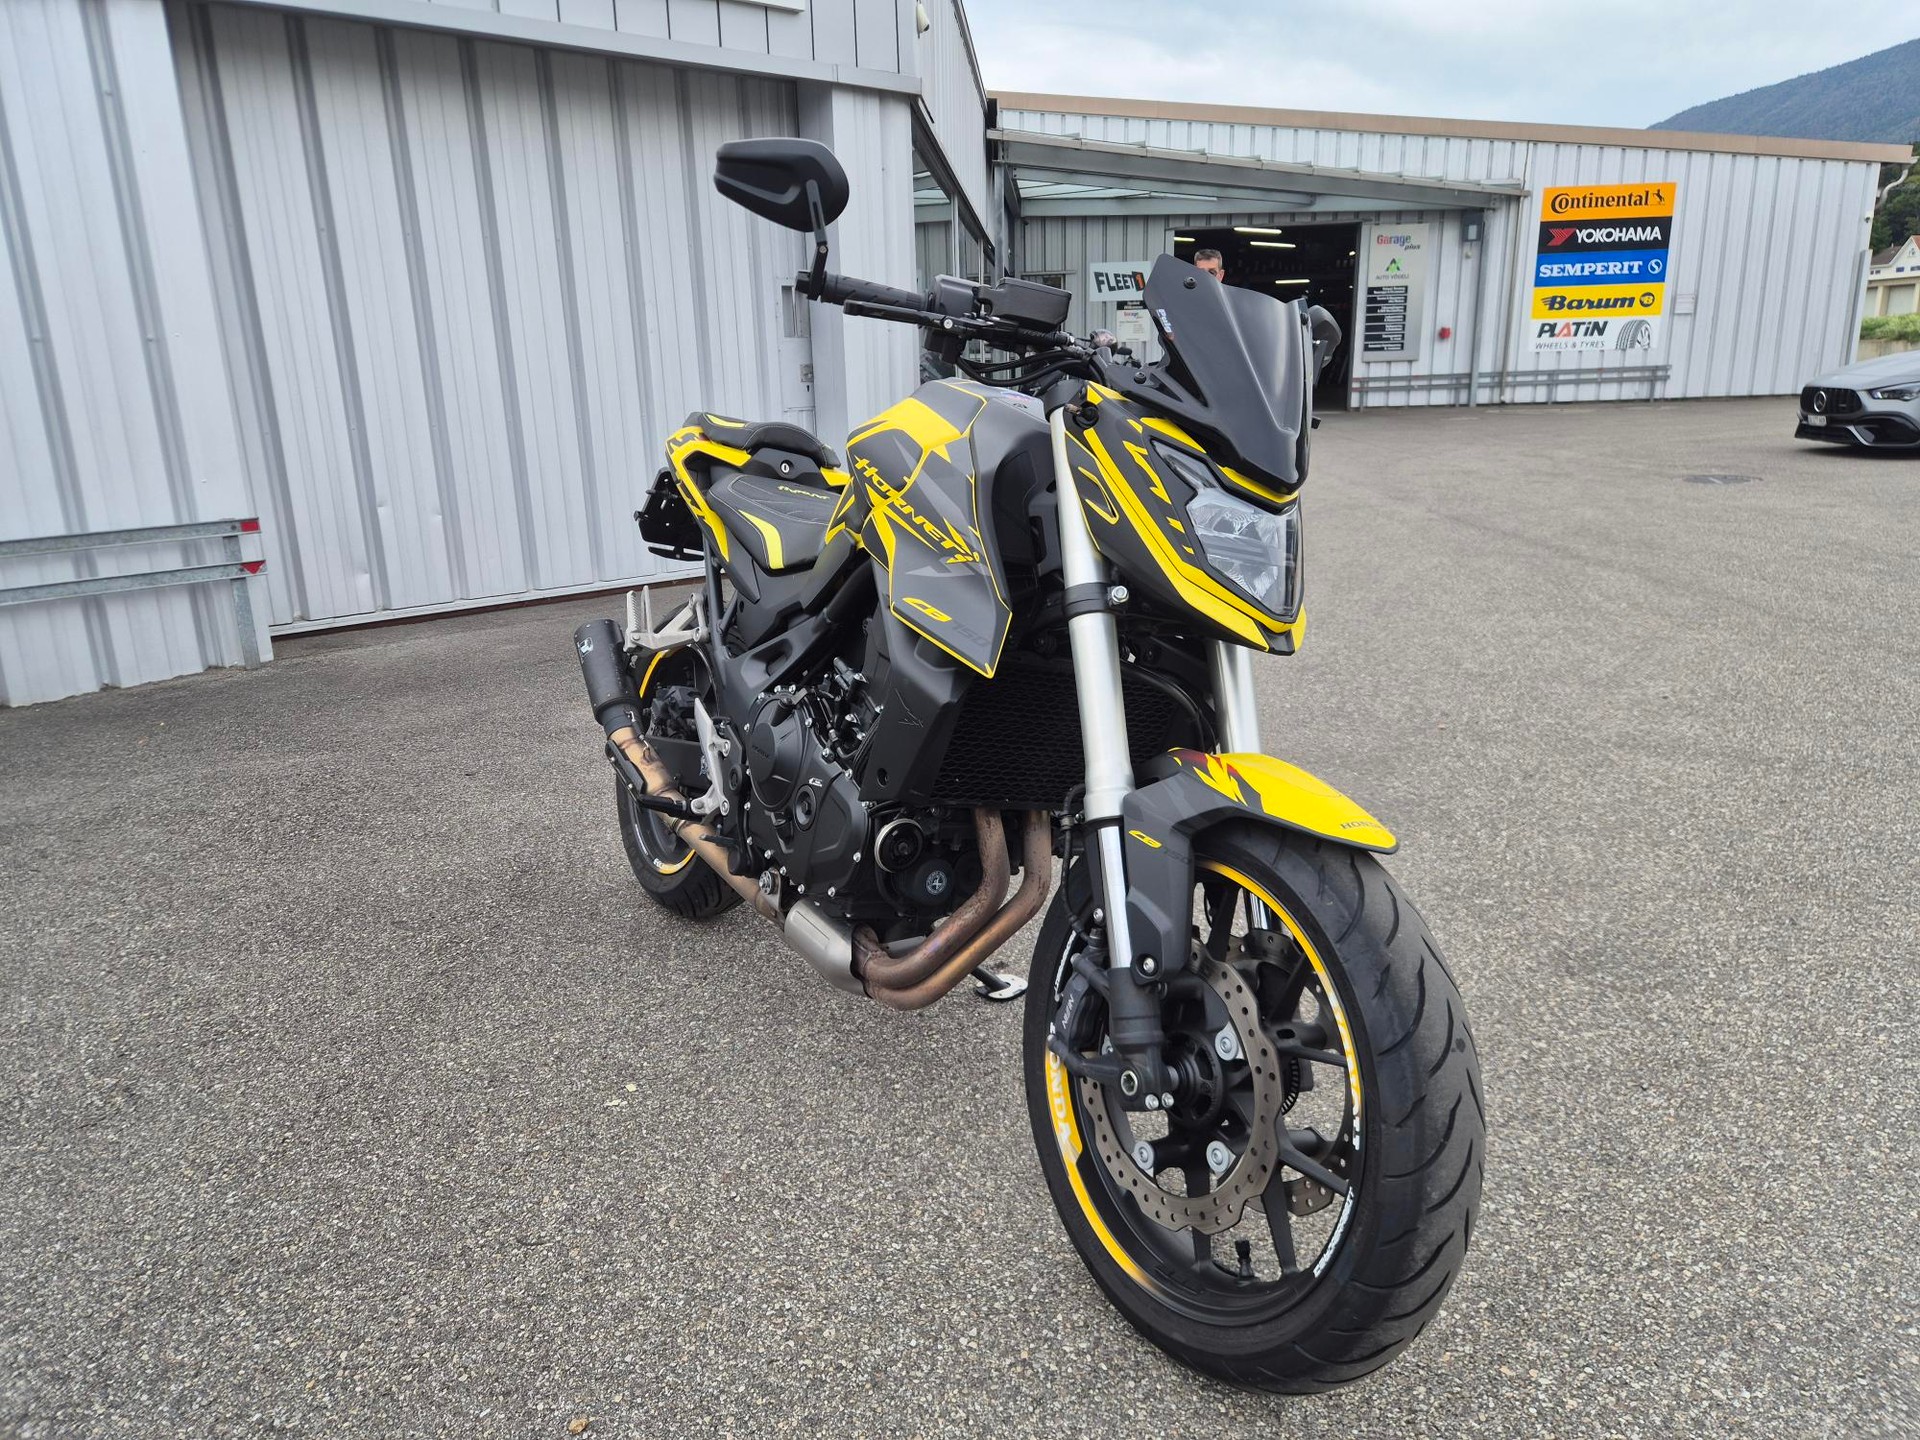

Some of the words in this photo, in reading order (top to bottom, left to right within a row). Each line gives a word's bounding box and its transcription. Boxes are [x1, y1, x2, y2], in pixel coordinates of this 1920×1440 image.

[1551, 190, 1649, 214] Continental
[1377, 234, 1411, 247] Garage
[1576, 226, 1662, 243] YOKOHAMA
[1539, 261, 1643, 277] SEMPERIT
[1541, 295, 1636, 311] Barum
[1580, 340, 1605, 348] TYRES
